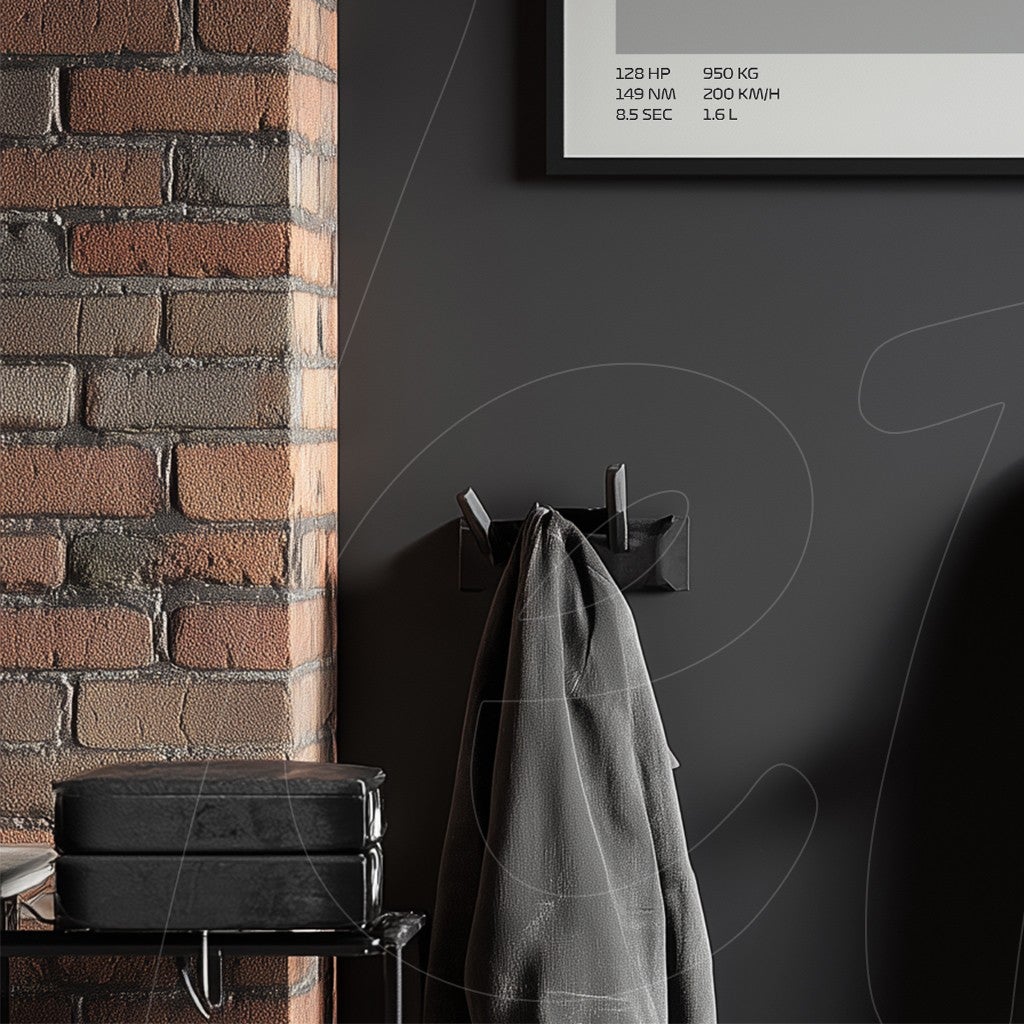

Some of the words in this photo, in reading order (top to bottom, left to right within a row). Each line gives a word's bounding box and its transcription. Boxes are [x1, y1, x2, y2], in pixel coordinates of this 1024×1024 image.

[615, 67, 645, 80] 128
[648, 67, 671, 80] HP
[703, 67, 734, 80] 950
[737, 67, 759, 80] KG
[615, 87, 645, 100] 149
[648, 87, 677, 100] NM
[703, 87, 735, 100] 200
[738, 87, 780, 101] KM/H
[615, 108, 639, 121] 8.5
[642, 108, 673, 121] SEC
[703, 108, 726, 121] 1.6
[728, 108, 738, 121] L
